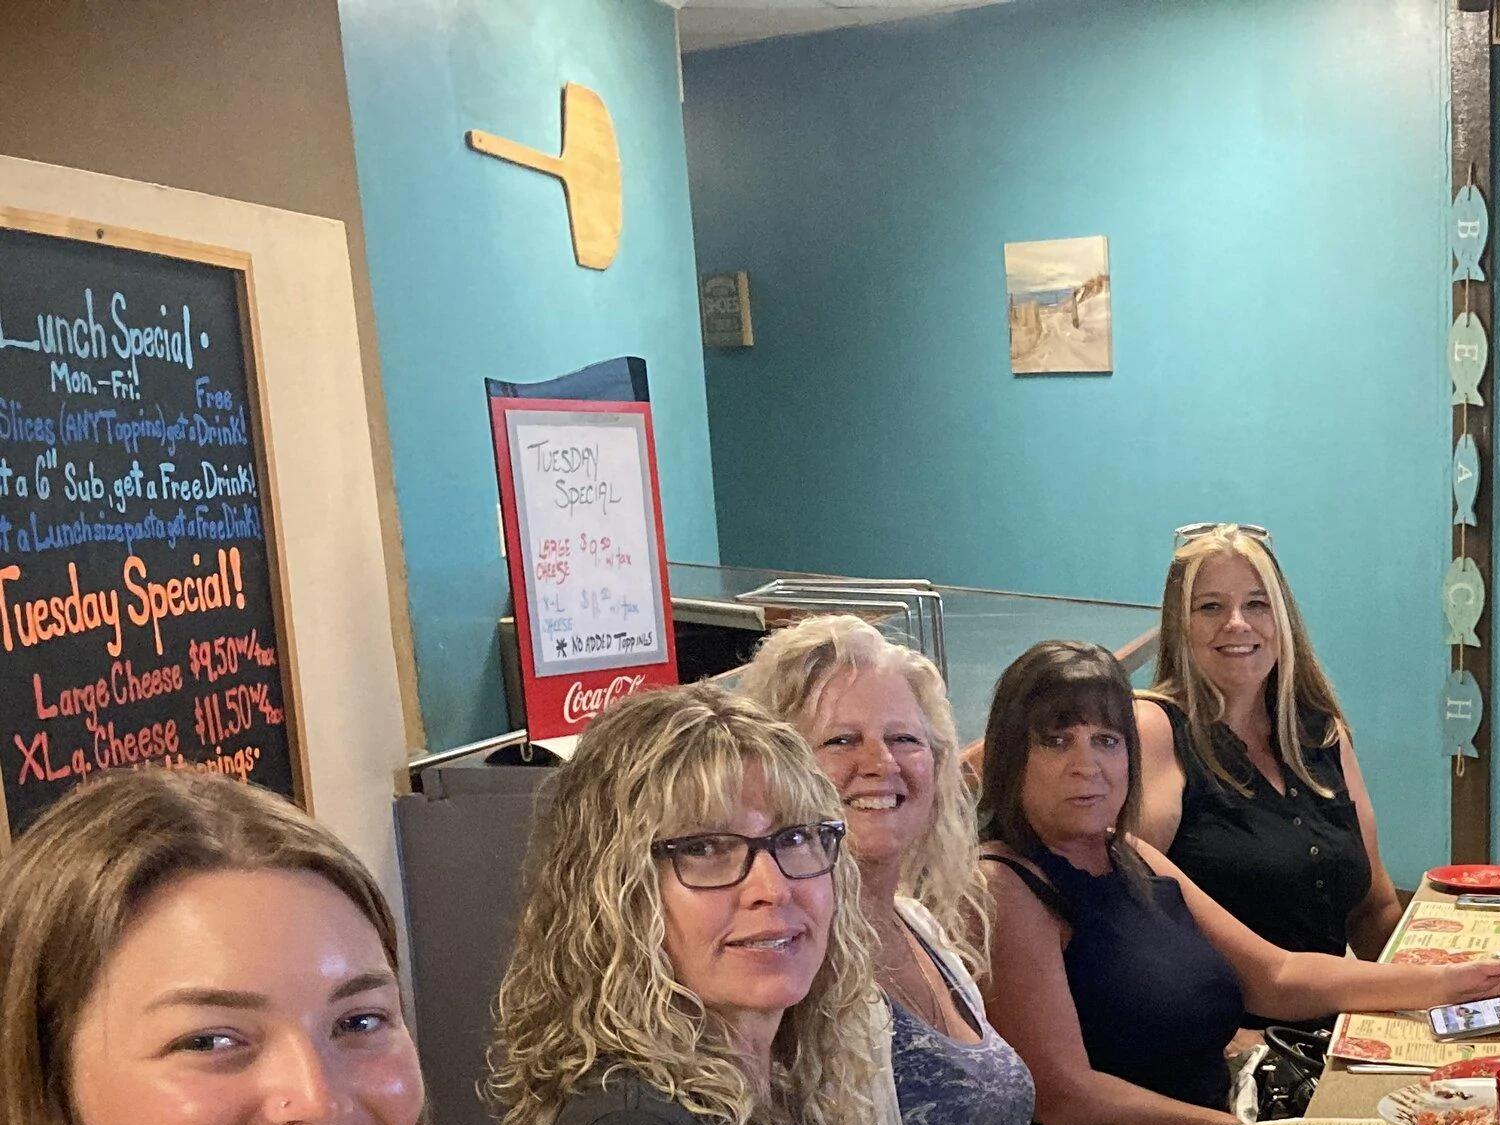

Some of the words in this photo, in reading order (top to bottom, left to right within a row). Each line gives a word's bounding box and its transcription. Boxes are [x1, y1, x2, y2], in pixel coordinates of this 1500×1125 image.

[195, 376, 233, 411] Free
[193, 404, 248, 447] Drink!
[526, 440, 602, 483] TUESDAY
[114, 459, 144, 514] get
[147, 478, 157, 499] a
[159, 462, 203, 502] Free
[201, 460, 259, 500] Drink!
[554, 478, 623, 516] SPECIAL
[0, 561, 123, 658] Tuesday
[124, 546, 246, 656] Special!
[571, 634, 585, 656] NO
[585, 631, 613, 654] ADDED
[33, 672, 110, 732] Large
[110, 659, 183, 706] Cheese
[94, 718, 180, 770] Cheese
